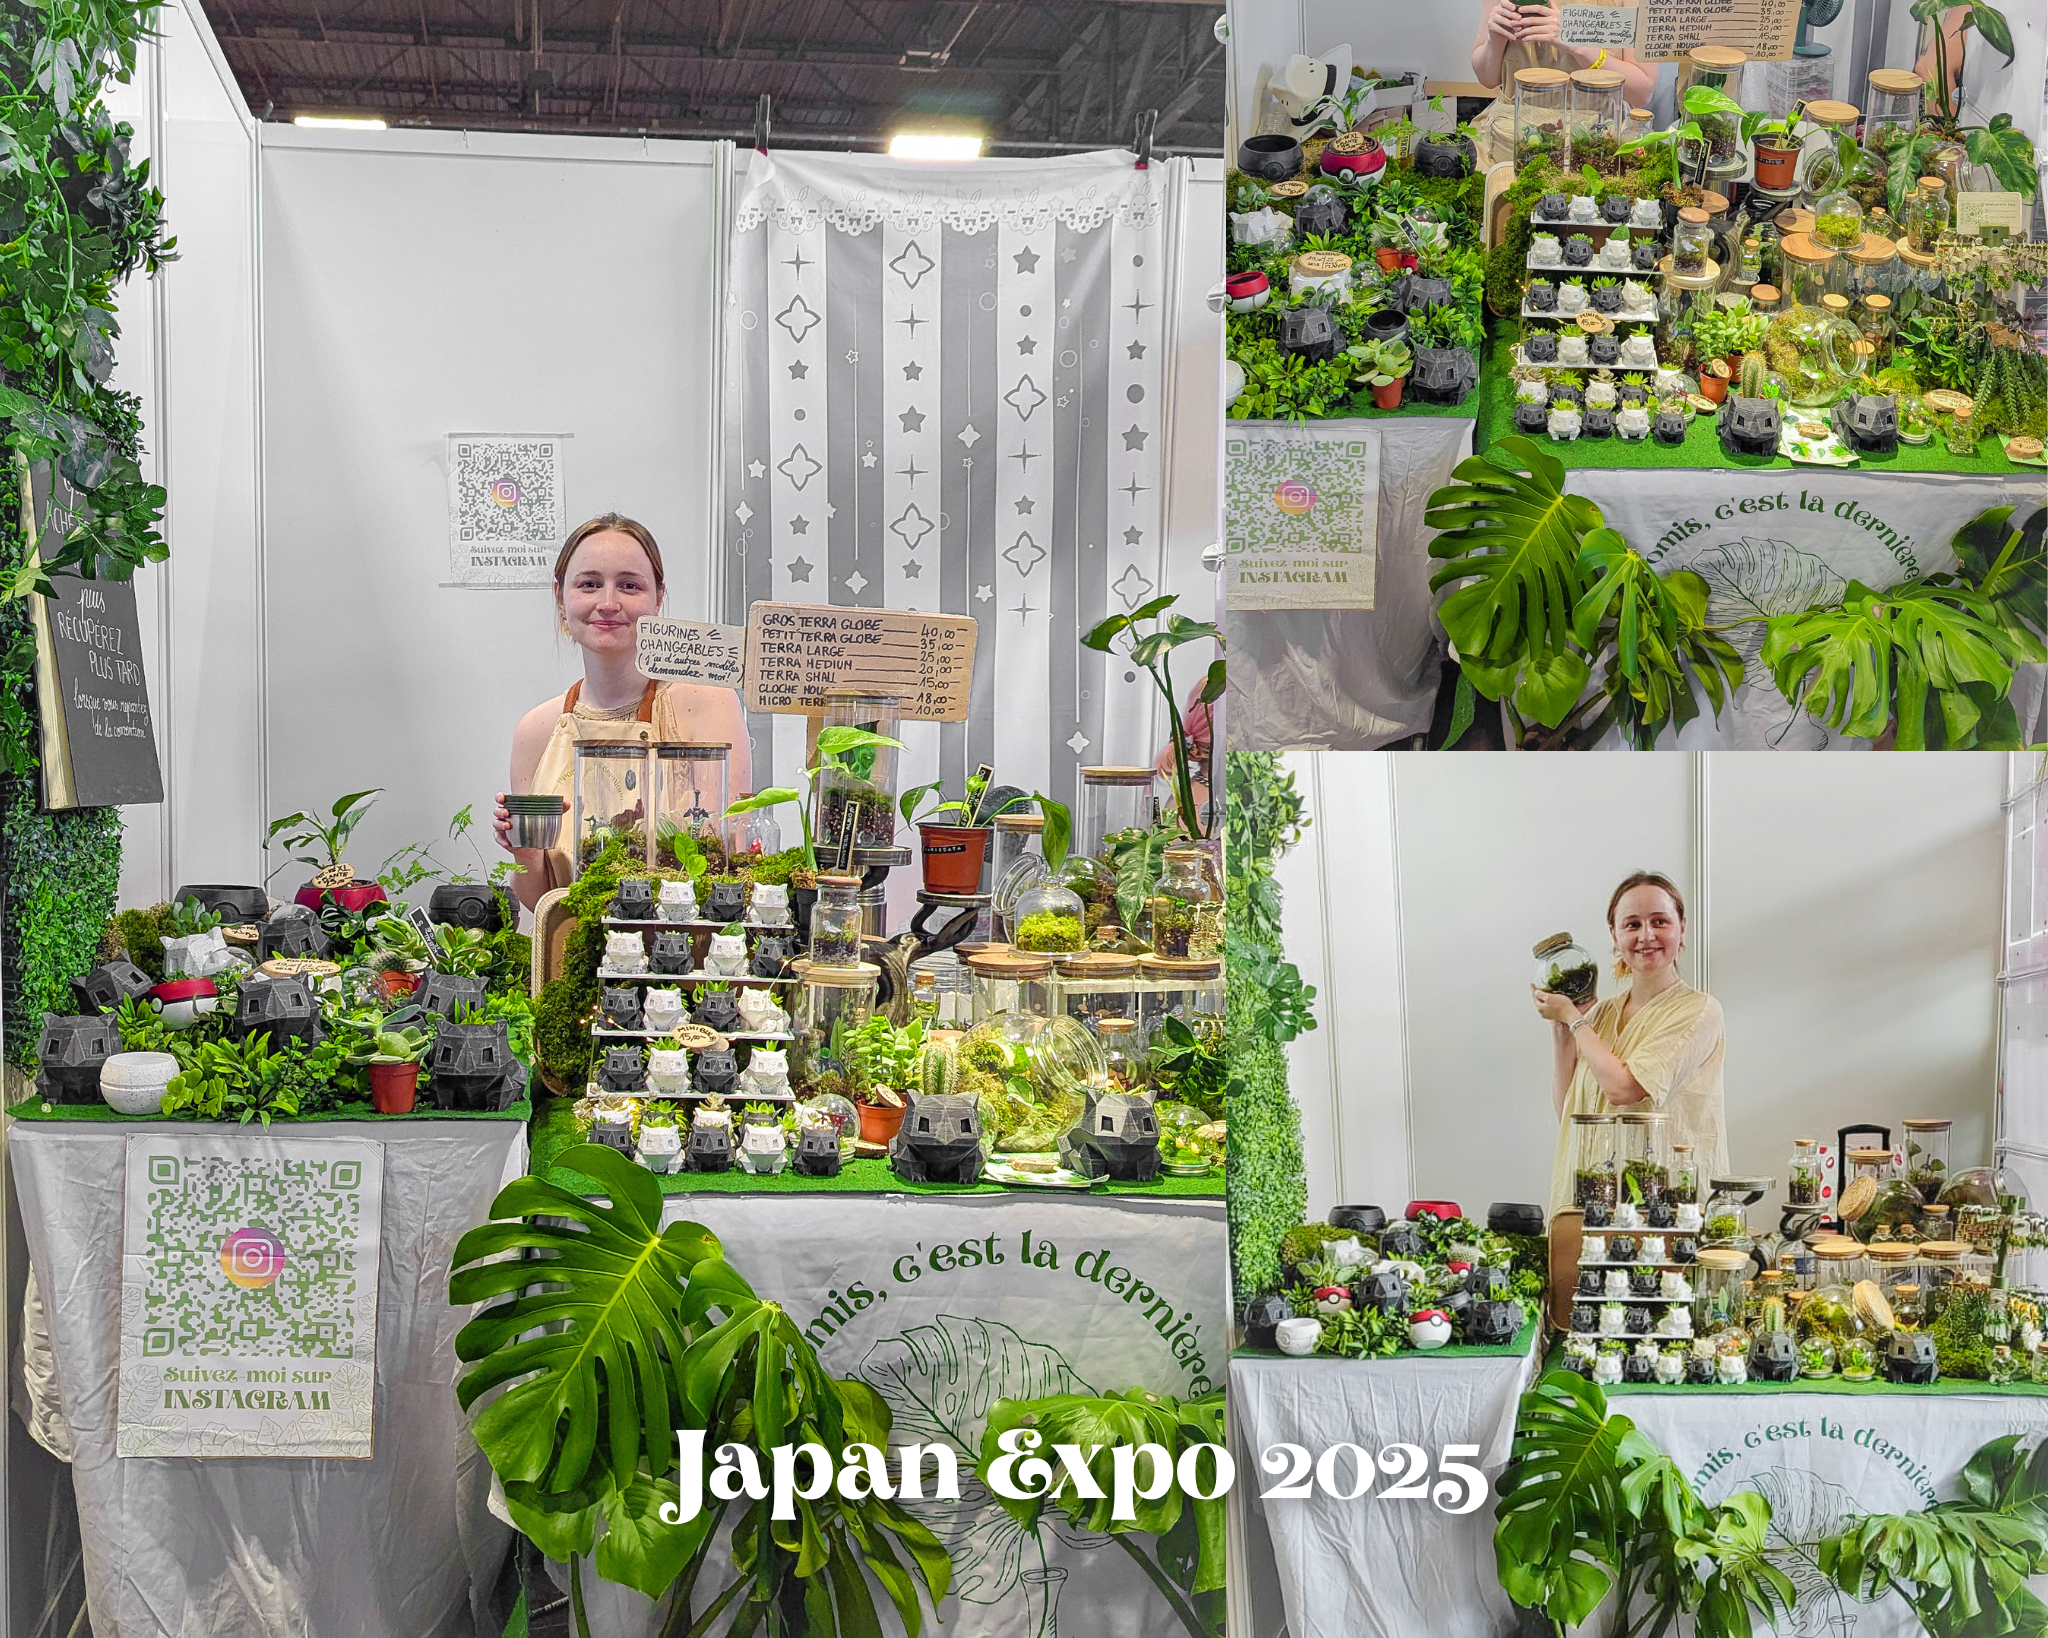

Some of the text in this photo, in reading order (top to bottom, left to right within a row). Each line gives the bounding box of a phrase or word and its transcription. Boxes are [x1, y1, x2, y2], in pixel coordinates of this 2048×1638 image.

[1761, 0, 1785, 8] 40,00
[1563, 9, 1604, 19] FIGURINES
[1760, 16, 1781, 25] 25,00
[1563, 20, 1621, 29] CHANGEABLES
[1759, 24, 1782, 32] 20,00
[1758, 33, 1779, 41] 15,00
[1715, 490, 1789, 520] c'est
[1799, 490, 1826, 514] la
[1834, 500, 1920, 581] dernière
[528, 546, 547, 554] sur
[471, 556, 547, 567] INSTAGRAM
[1322, 560, 1348, 568] sur
[1239, 571, 1348, 583] INSTAGRAM
[77, 587, 105, 623] puis
[58, 610, 124, 655] RÉCUPÉREZ
[641, 623, 700, 641] FIGURINES
[763, 614, 955, 639] GROS TERRA GLOBE 40,00
[641, 639, 724, 657] CHANGEABLES
[799, 632, 836, 643] TERRA
[840, 633, 883, 644] GLOBE
[921, 639, 953, 651] 35,00
[760, 642, 951, 665] TERRA LARGE 25,00
[89, 650, 140, 686] PLUS TARD
[760, 657, 952, 677] TERRA MEDIUM 20,00
[760, 670, 949, 690] TERRA SMALL 15,00
[74, 677, 102, 728] lorsque
[759, 684, 798, 694] CLOCHE
[917, 692, 947, 704] 18,00
[759, 696, 791, 706] MICRO
[916, 705, 945, 716] 10,00
[94, 715, 102, 736] de
[337, 864, 350, 873] XL
[679, 1033, 700, 1042] 15,00
[804, 1229, 1212, 1400] mis, c'est la dernière
[291, 1370, 332, 1384] sur
[164, 1389, 332, 1410] INSTAGRAM
[1744, 1417, 1811, 1448] c'est
[1821, 1416, 1844, 1440] la
